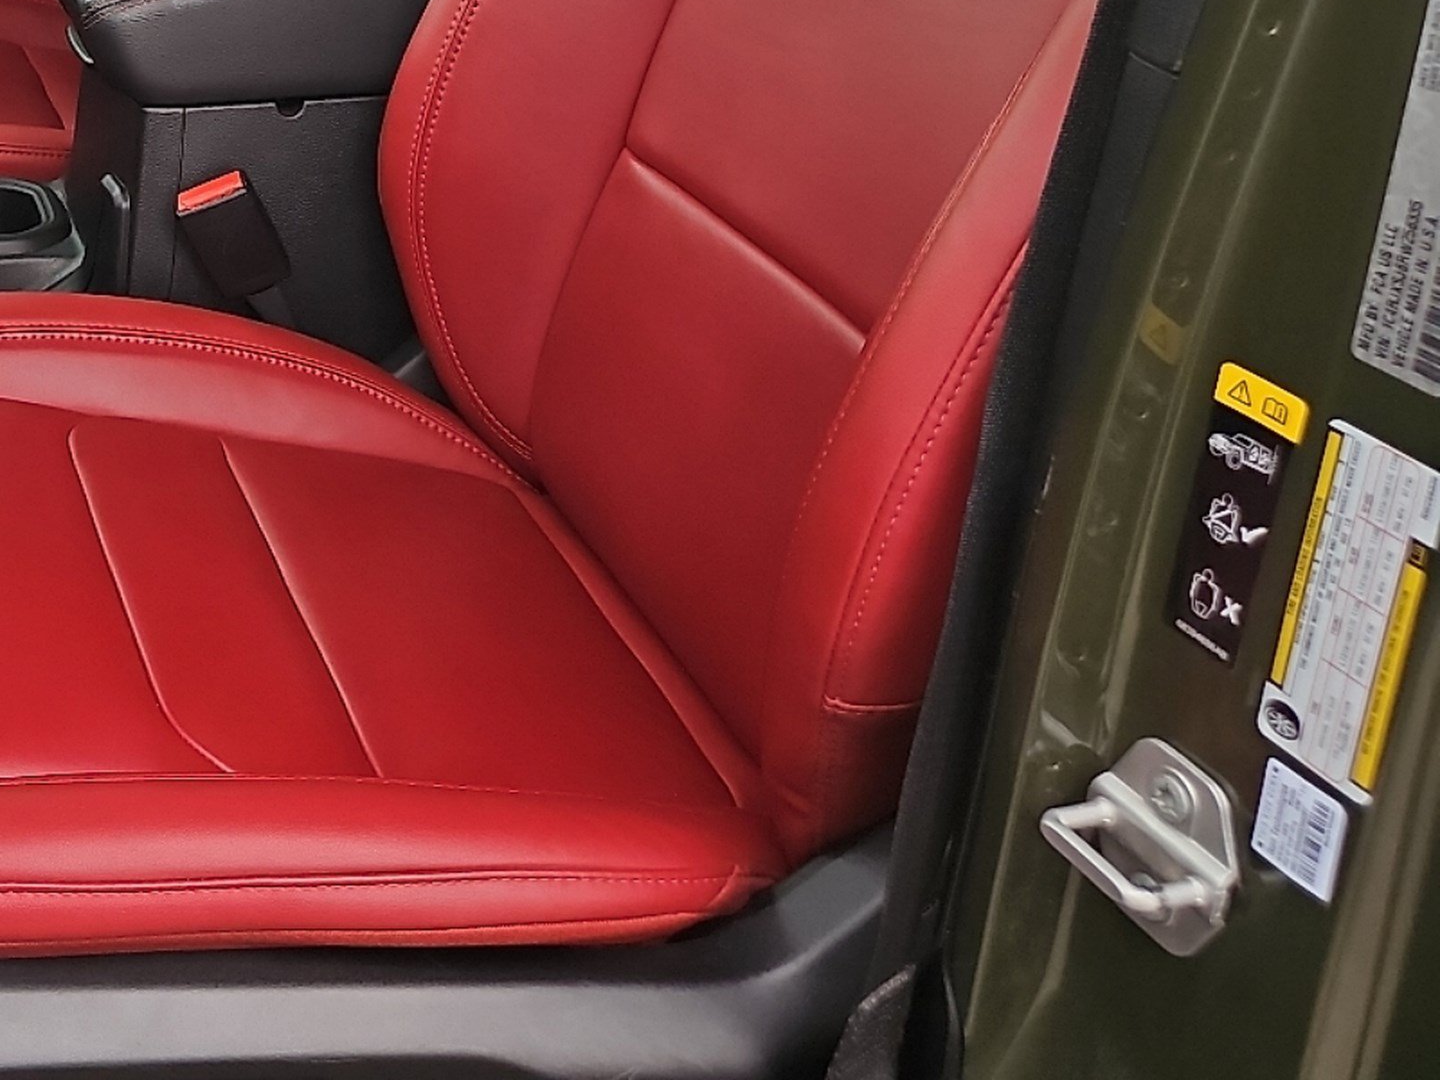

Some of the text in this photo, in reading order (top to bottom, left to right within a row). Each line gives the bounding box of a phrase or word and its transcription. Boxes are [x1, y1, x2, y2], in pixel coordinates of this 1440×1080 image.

[1382, 222, 1398, 247] LLC
[1376, 248, 1392, 268] US
[1370, 271, 1388, 296] FCA
[1391, 315, 1414, 368] VEHICLE
[1404, 275, 1424, 315] MADE
